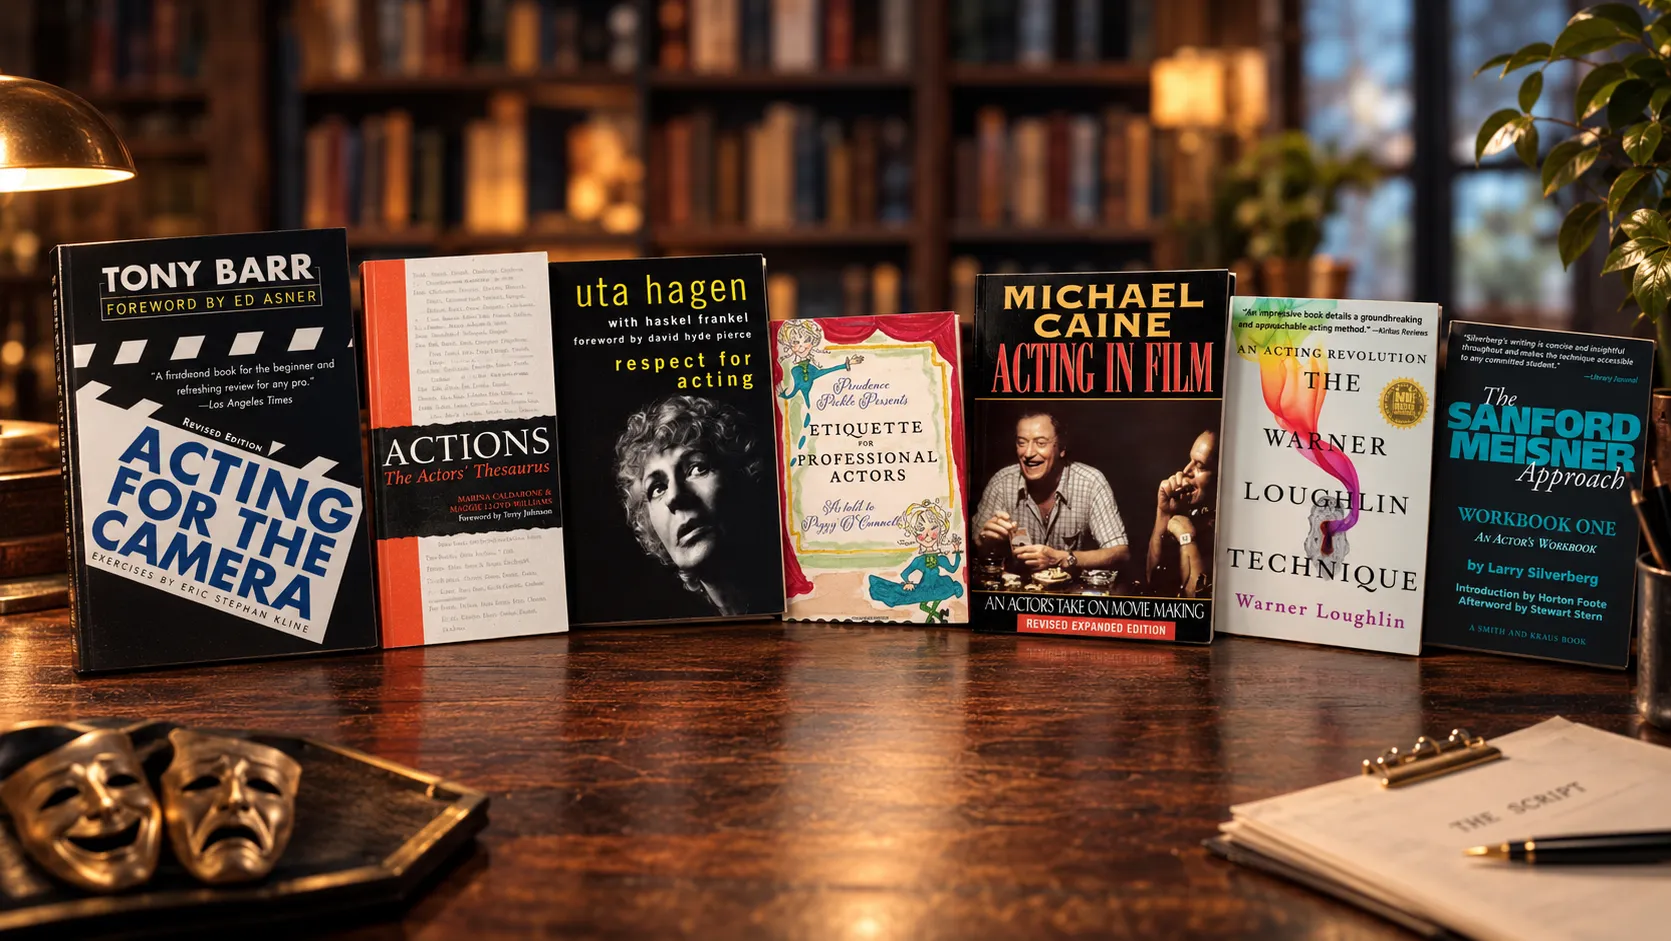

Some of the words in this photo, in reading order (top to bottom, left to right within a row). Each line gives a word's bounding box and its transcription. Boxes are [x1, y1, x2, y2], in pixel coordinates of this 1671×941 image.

[102, 260, 201, 292] TONY
[216, 253, 314, 285] BARR
[107, 299, 196, 315] FOREWORD
[206, 296, 224, 309] BY
[235, 294, 254, 306] ED
[264, 291, 316, 304] ASNER
[577, 278, 628, 307] uta
[647, 275, 746, 309] hagen
[1004, 283, 1204, 310] MICHAEL
[608, 317, 638, 328] with
[646, 315, 691, 326] haskel
[698, 312, 748, 324] frankel
[1034, 312, 1170, 338] CAINE
[1304, 310, 1323, 319] book
[1326, 312, 1351, 320] details
[574, 336, 624, 345] foreword
[630, 335, 642, 344] by
[649, 333, 678, 342] david
[685, 332, 711, 342] hyde
[717, 331, 752, 341] pierce
[1308, 324, 1332, 333] acting
[1237, 345, 1256, 354] AN
[1264, 346, 1321, 357] ACTING
[1328, 350, 1427, 364] REVOLUTION
[1462, 344, 1503, 354] throughout
[1559, 354, 1595, 363] technique
[1597, 357, 1634, 365] accessible
[1510, 339, 1536, 349] writing
[1546, 342, 1573, 350] concise
[1575, 344, 1589, 352] and
[214, 366, 236, 376] book
[240, 365, 252, 374] for
[256, 364, 269, 373] the
[274, 362, 314, 374] beginner
[317, 359, 335, 369] and
[616, 353, 705, 373] respect
[720, 351, 751, 366] for
[991, 342, 1095, 393] ACTING
[1105, 343, 1134, 393] IN
[1144, 342, 1214, 393] FILM
[1470, 355, 1483, 363] any
[177, 383, 221, 396] refreshing
[225, 381, 254, 391] review
[256, 380, 269, 389] for
[272, 380, 288, 391] any
[678, 371, 753, 390] acting
[833, 378, 890, 395] Prudence
[1304, 372, 1360, 392] THE
[227, 397, 263, 409] Angeles
[267, 395, 293, 405] Times
[1484, 386, 1517, 406] The
[810, 421, 923, 438] ETIQUETTE
[1448, 402, 1640, 441] SANFORD
[382, 427, 550, 466] ACTIONS
[1263, 428, 1387, 456] WARNER
[1450, 431, 1635, 472] MEISNER
[798, 451, 938, 466] PROFESSIONAL
[118, 426, 353, 534] ACTING
[385, 471, 412, 486] The
[473, 462, 550, 479] Thesaurus
[830, 469, 906, 483] ACTORS
[1516, 461, 1625, 492] Approach
[1244, 482, 1409, 515] LOUGHLIN
[108, 465, 218, 538] FOR
[236, 506, 336, 578] THE
[459, 513, 491, 521] Foreword
[493, 512, 501, 520] by
[1458, 507, 1571, 533] WORKBOOK
[1576, 519, 1616, 536] ONE
[92, 510, 311, 620] CAMERA
[1227, 548, 1418, 592] TECHNIQUE
[1467, 559, 1484, 574] by
[1488, 563, 1524, 578] Larry
[1528, 567, 1598, 587] Silverberg
[92, 552, 153, 580] EXERCISES
[160, 576, 174, 586] BY
[181, 583, 207, 598] ERIC
[215, 594, 267, 619] STEPHAN
[274, 616, 309, 634] KLINE
[1456, 583, 1519, 599] Introduction
[1523, 591, 1535, 602] by
[1539, 593, 1574, 605] Horton
[1577, 598, 1607, 609] Foote
[985, 596, 1005, 611] AN
[1056, 599, 1085, 615] TAKE
[1088, 600, 1108, 616] ON
[1111, 601, 1150, 618] MOVIE
[1153, 602, 1204, 619] MAKING
[1235, 593, 1307, 616] Warner
[1317, 603, 1405, 629] Loughlin
[1458, 596, 1512, 611] Afterword
[1515, 603, 1527, 614] by
[1530, 605, 1571, 618] Stewart
[1574, 610, 1603, 621] Stern
[1026, 618, 1068, 630] REVISED
[1072, 620, 1123, 633] EXPANDED
[1127, 623, 1166, 635] EDITION
[1478, 625, 1505, 635] SMITH
[1508, 629, 1528, 638] AND
[1530, 632, 1558, 642] KRAUS
[1561, 636, 1586, 645] BOOK
[1450, 812, 1501, 833] THE
[1508, 781, 1587, 814] SCRIPT
